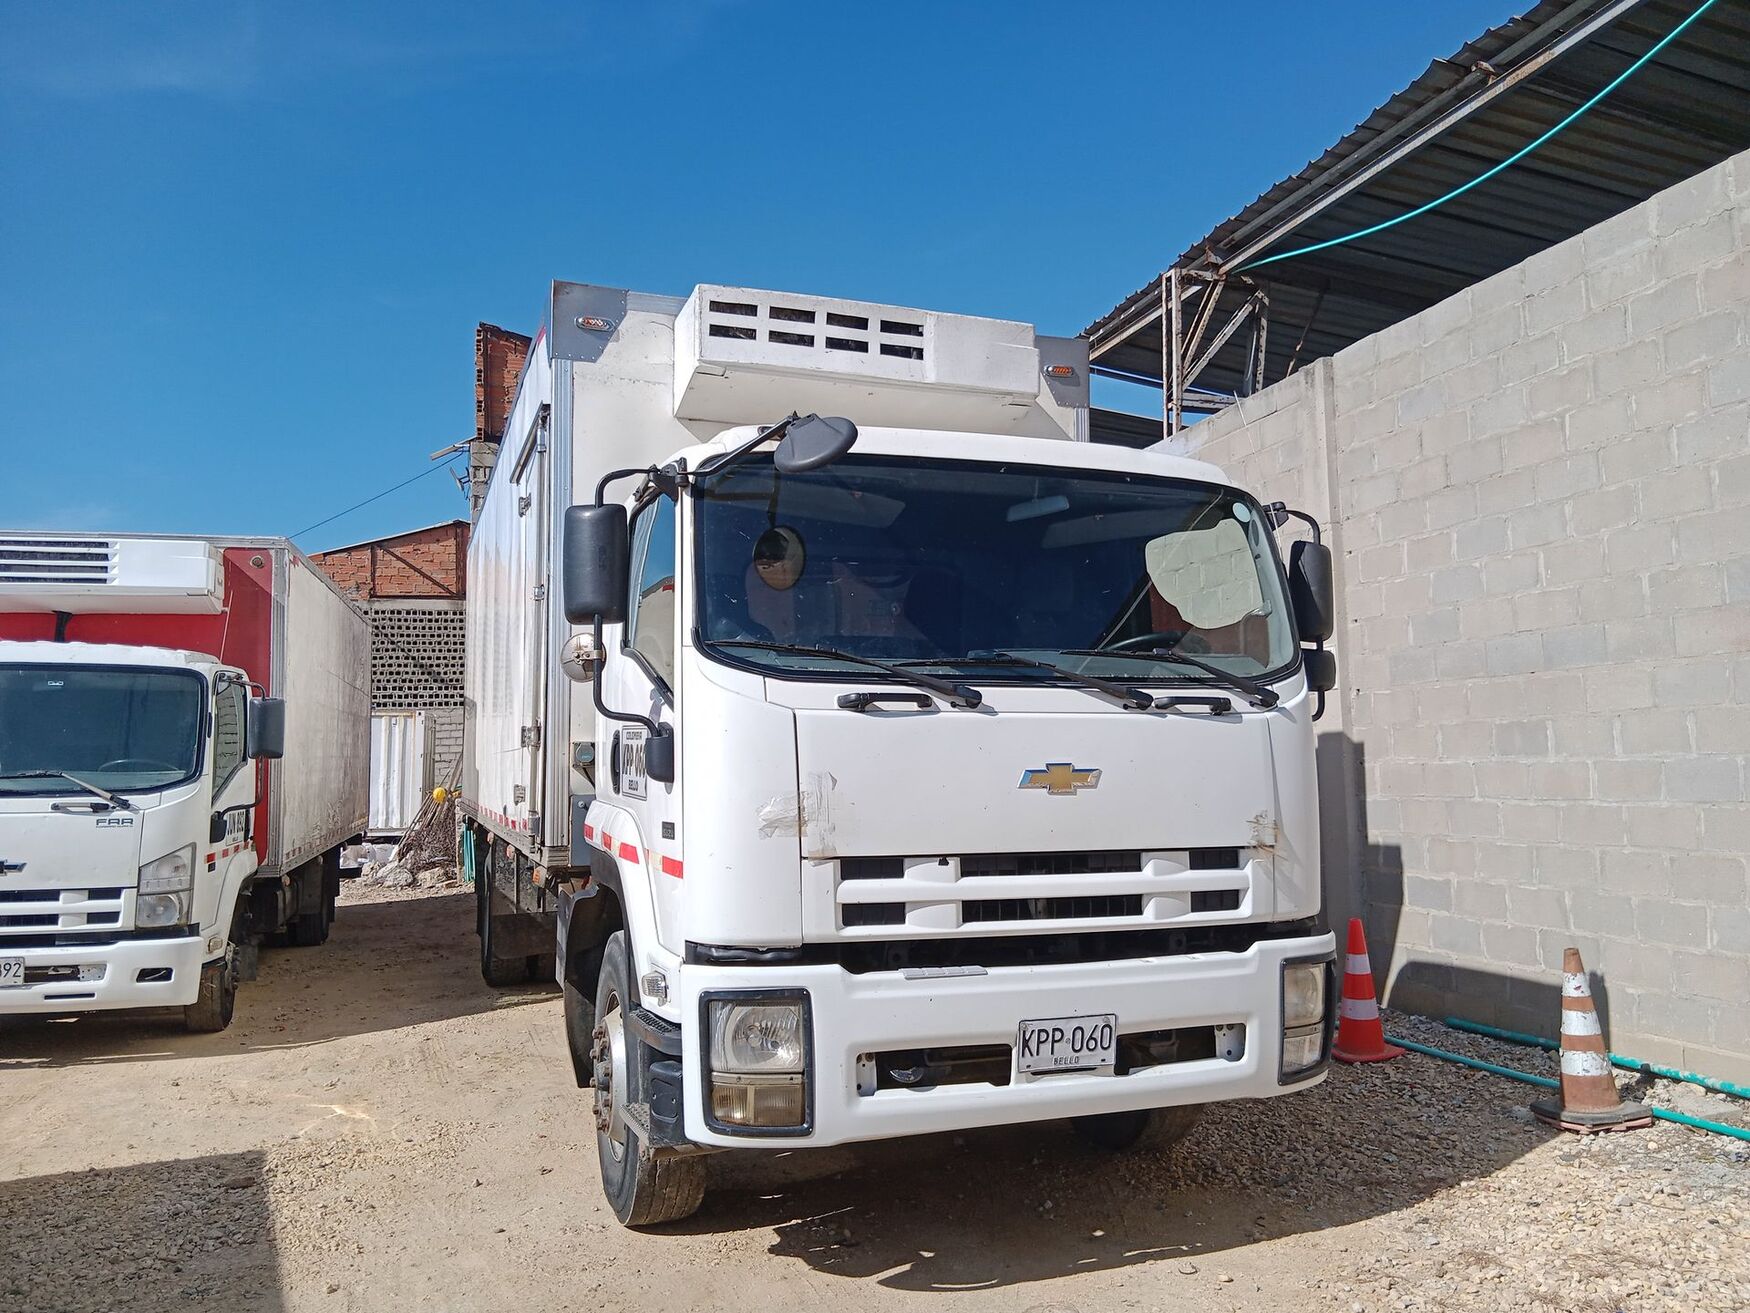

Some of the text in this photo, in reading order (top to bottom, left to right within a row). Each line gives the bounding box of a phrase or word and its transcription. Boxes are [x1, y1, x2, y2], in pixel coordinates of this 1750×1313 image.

[0, 962, 21, 978] 92
[1021, 1023, 1113, 1058] KPP 060
